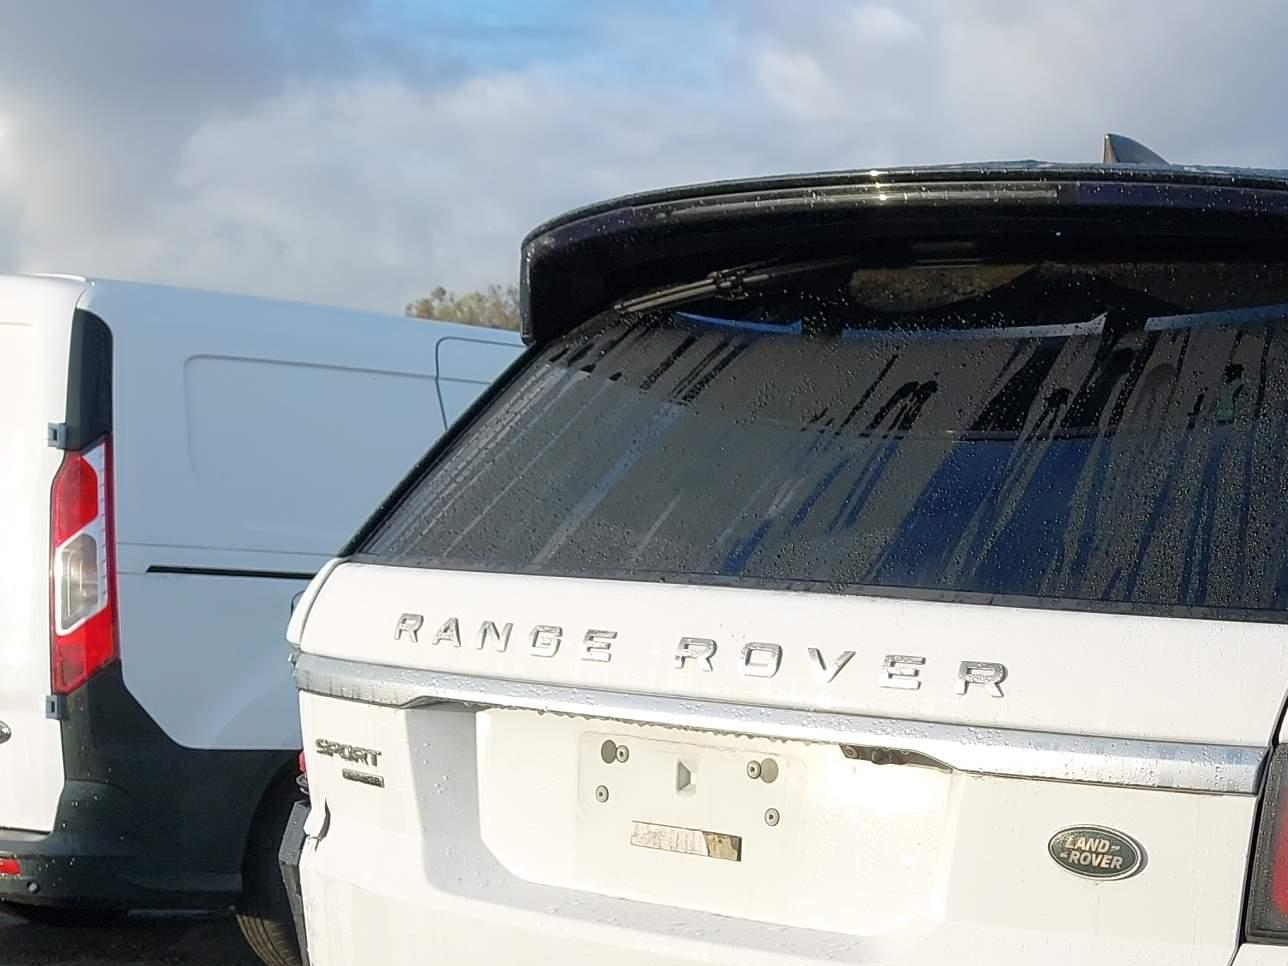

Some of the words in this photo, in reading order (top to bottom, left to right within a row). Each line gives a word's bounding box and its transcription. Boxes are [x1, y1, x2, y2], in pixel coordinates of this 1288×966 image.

[393, 612, 618, 663] RANGE
[675, 636, 1009, 698] ROVER
[315, 738, 382, 767] SPORT
